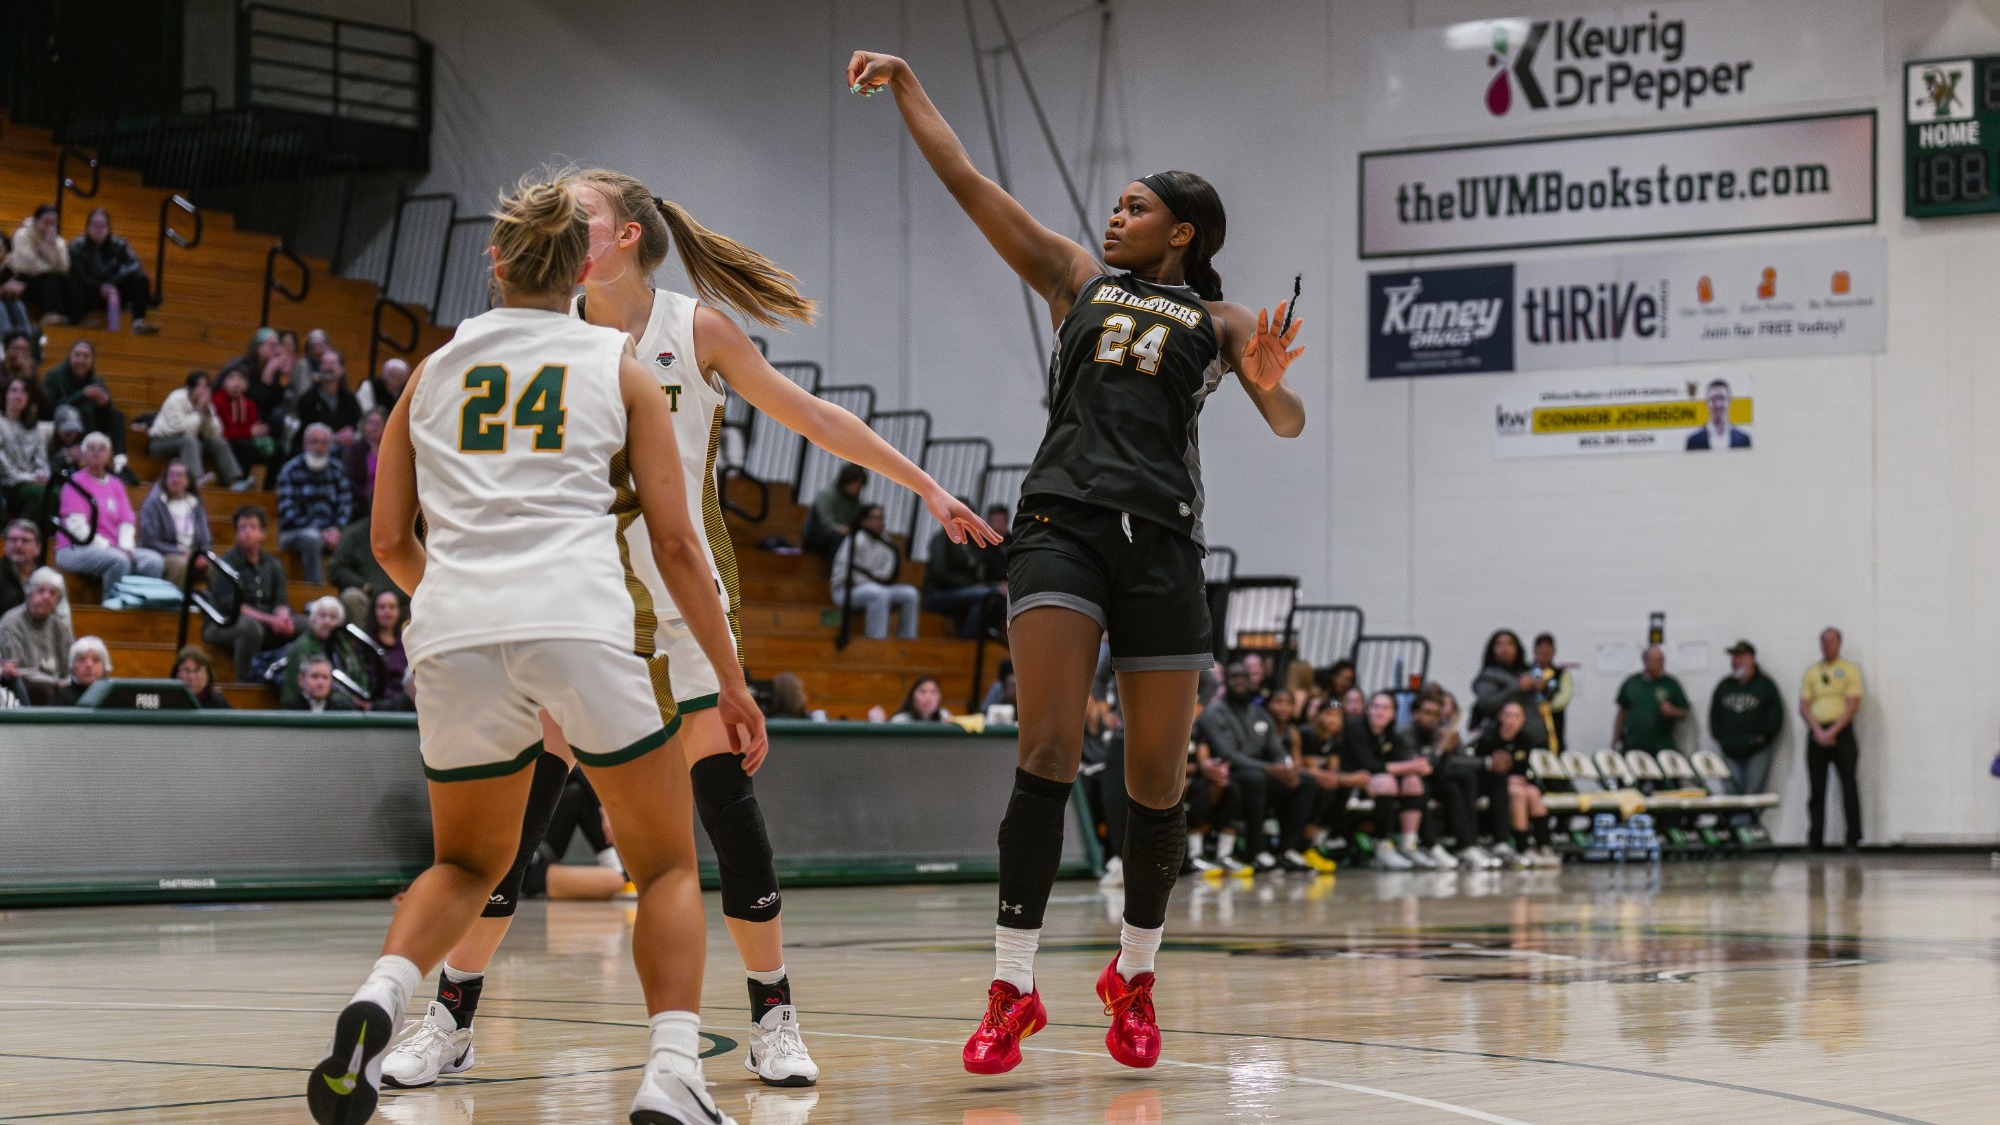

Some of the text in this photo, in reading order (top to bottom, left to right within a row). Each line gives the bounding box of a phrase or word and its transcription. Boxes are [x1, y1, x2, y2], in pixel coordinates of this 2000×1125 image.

[1556, 11, 1683, 62] Keurig
[1556, 61, 1752, 109] DrPepper
[1919, 121, 1980, 148] HOME
[1398, 163, 1829, 223] theUVMBookstore.com
[1380, 284, 1502, 339] Kinney
[1094, 313, 1170, 375] 24
[459, 363, 568, 453] 24
[1537, 404, 1697, 430] CONNOR JOHNSON
